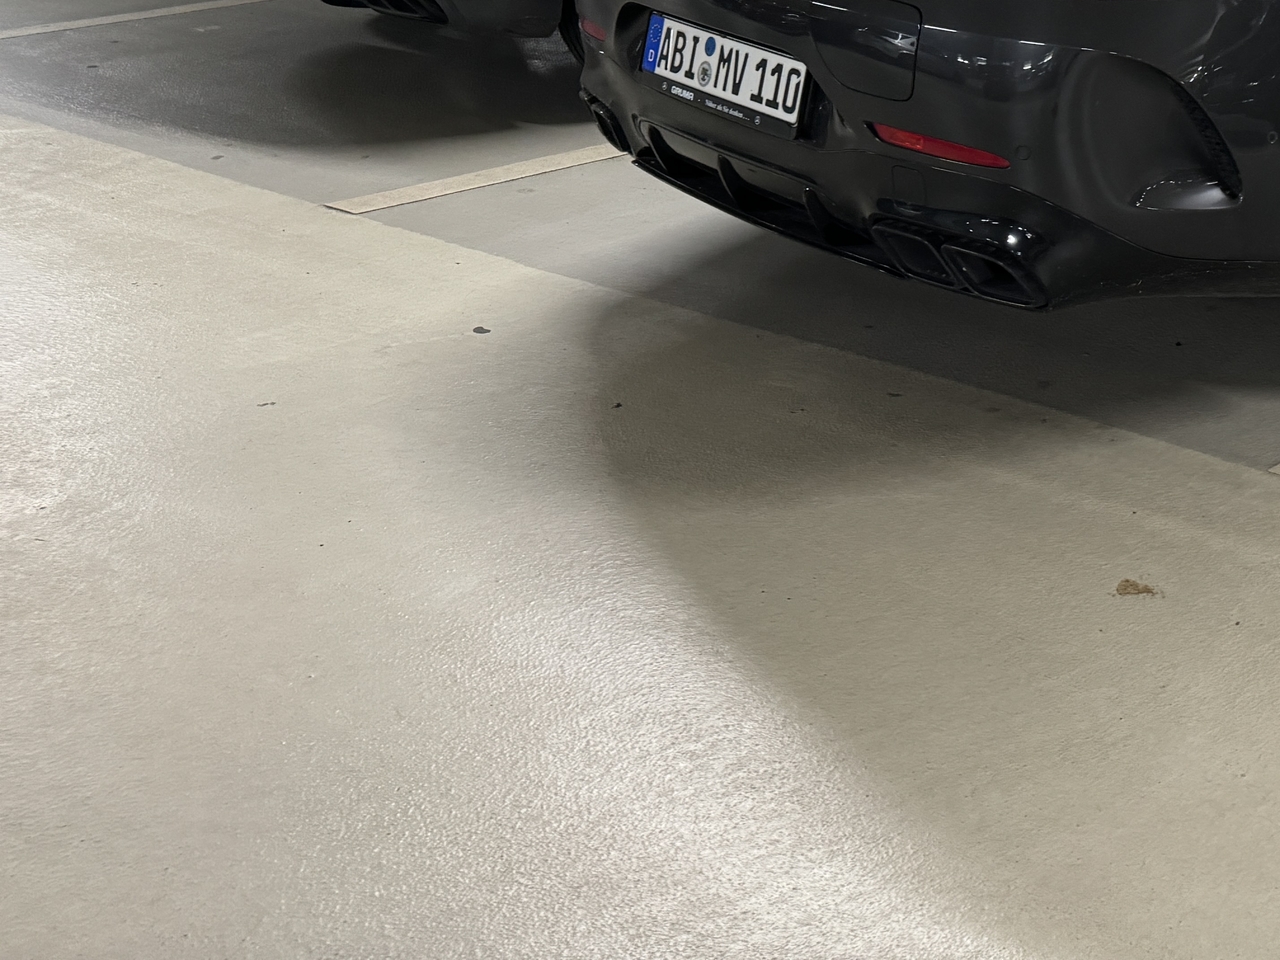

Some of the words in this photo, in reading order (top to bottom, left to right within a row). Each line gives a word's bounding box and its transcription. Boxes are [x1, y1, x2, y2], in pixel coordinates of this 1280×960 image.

[647, 49, 655, 62] D
[656, 26, 701, 81] ABI
[713, 44, 750, 96] MV
[750, 58, 802, 115] 110
[671, 85, 694, 101] GRUMA
